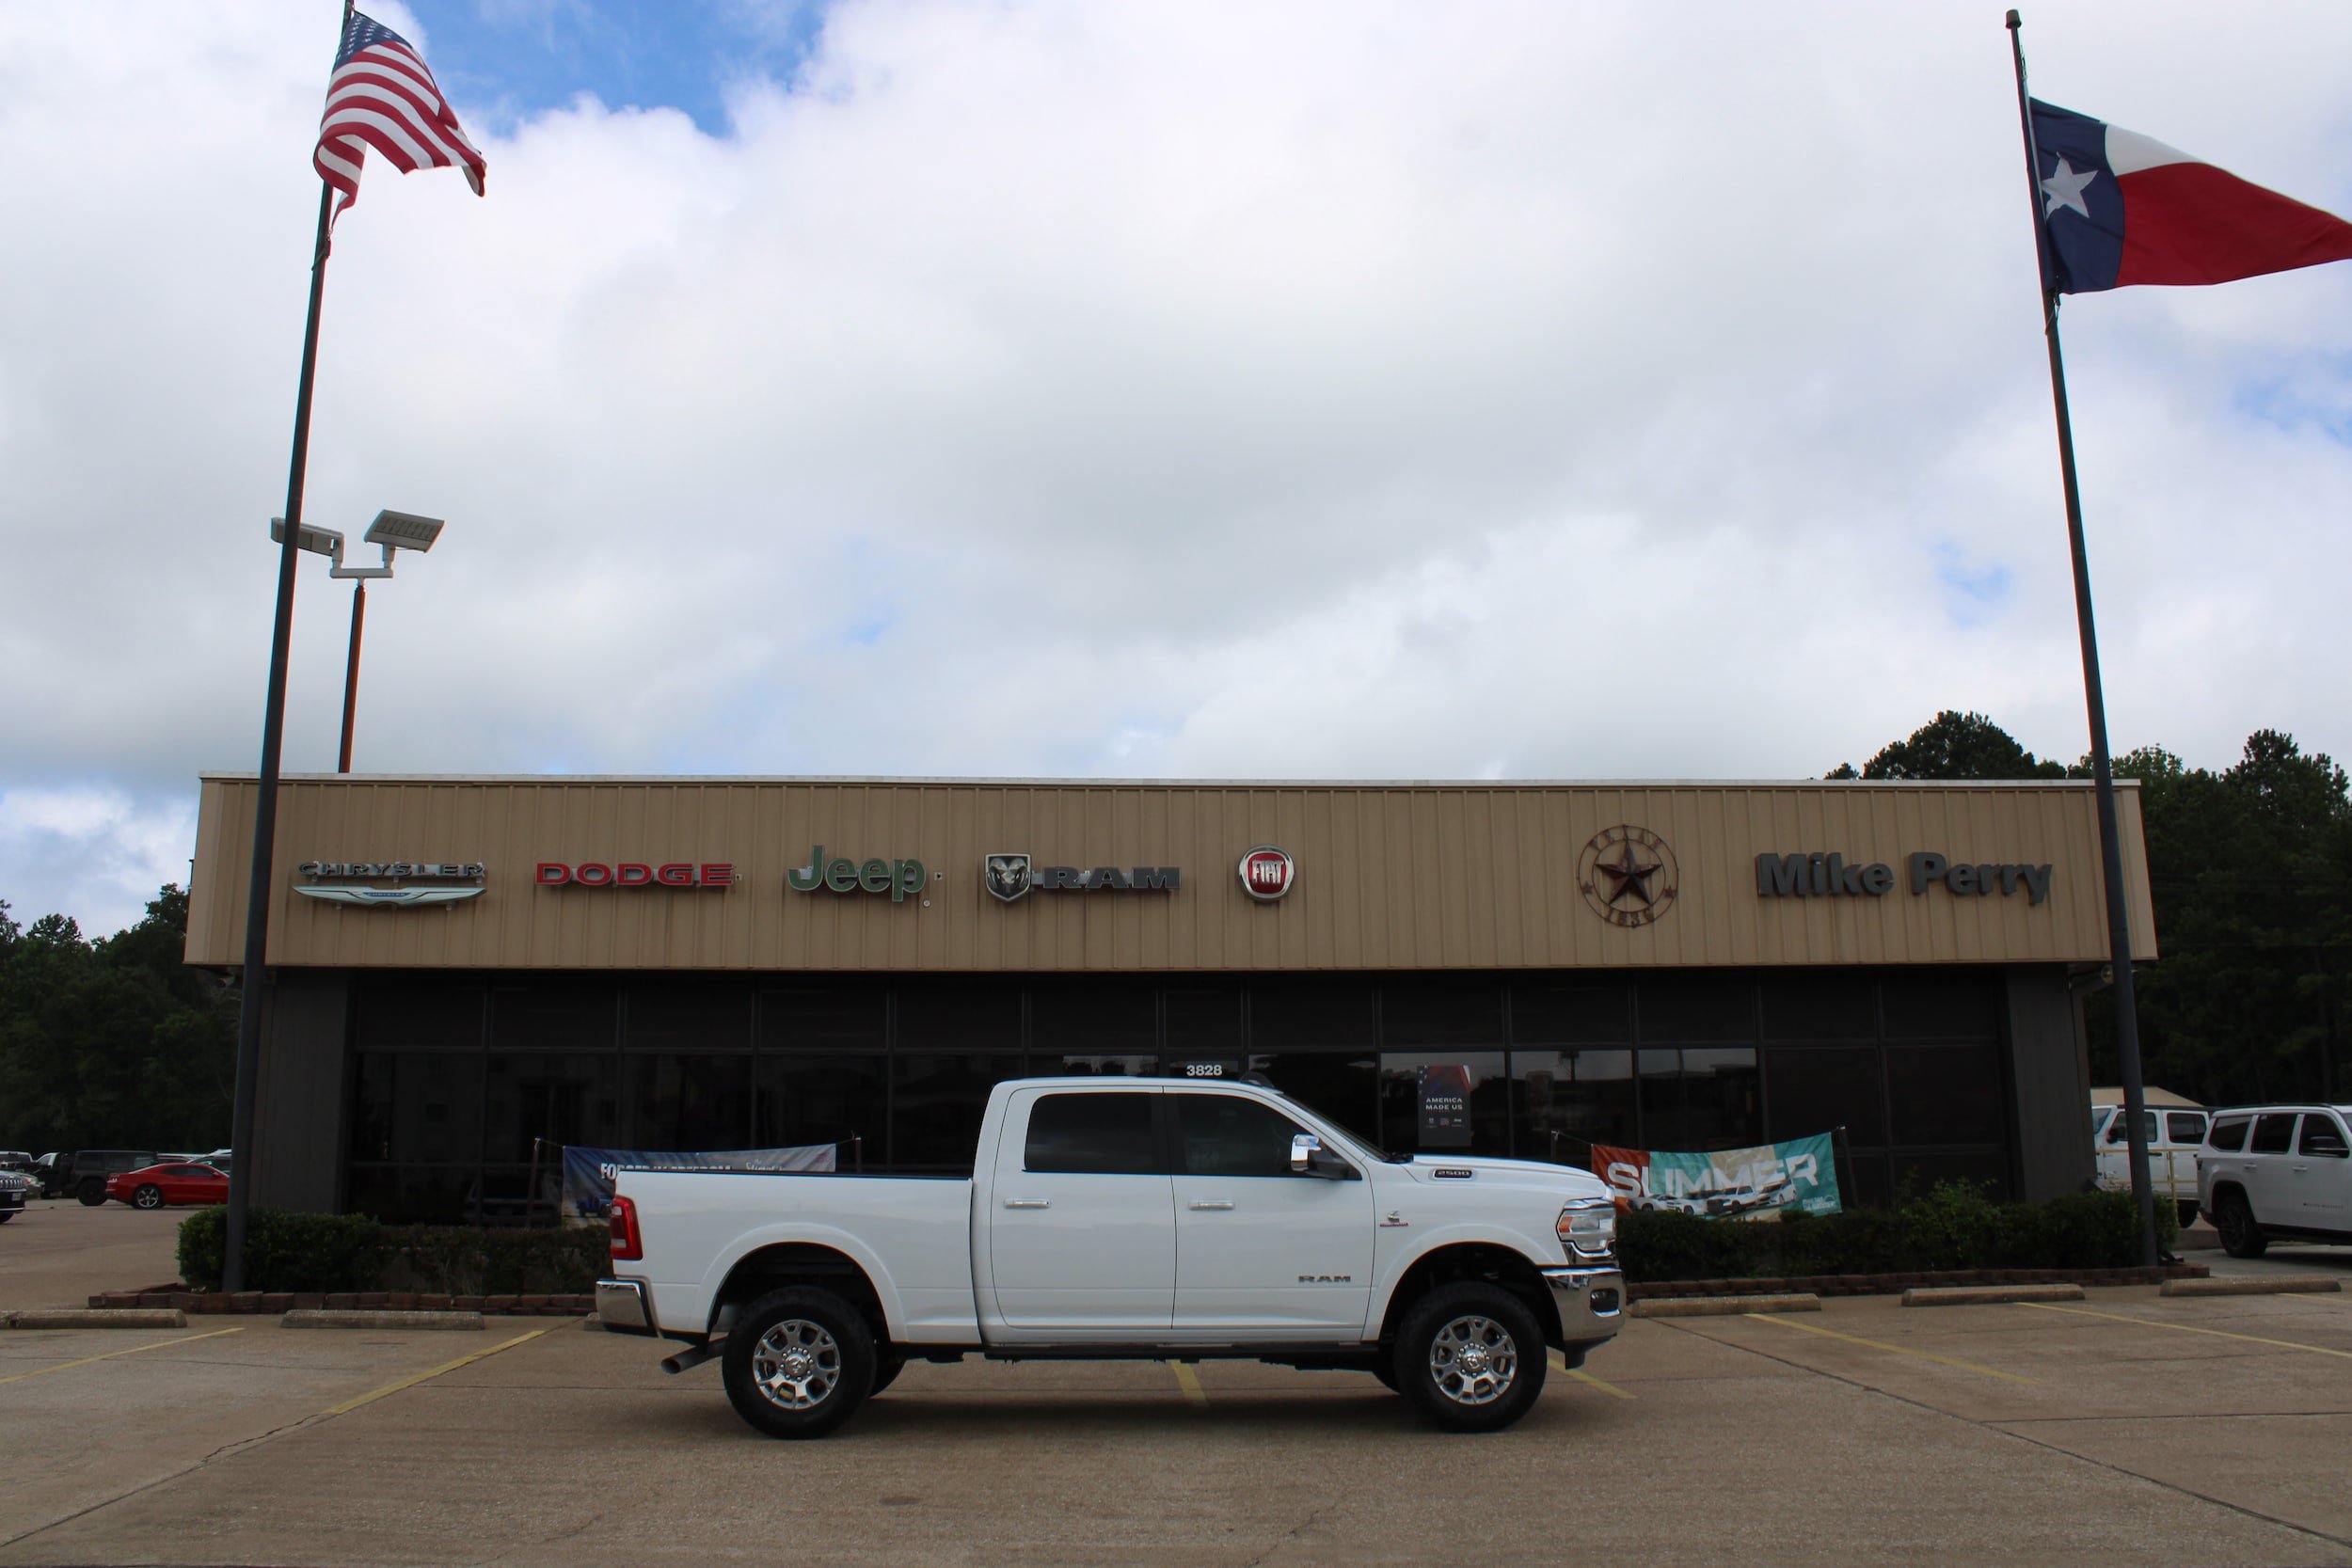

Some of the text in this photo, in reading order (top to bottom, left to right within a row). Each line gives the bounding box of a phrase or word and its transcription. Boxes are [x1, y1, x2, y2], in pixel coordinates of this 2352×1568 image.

[297, 862, 485, 878] CHRYSLER
[535, 863, 733, 886] DODGE
[787, 846, 926, 902] Jeep
[1041, 866, 1182, 889] RAM
[1251, 860, 1284, 885] FIAT
[1756, 851, 2053, 906] Mike Perry
[1186, 1064, 1223, 1076] 3828
[1607, 1152, 1820, 1198] SUMMER
